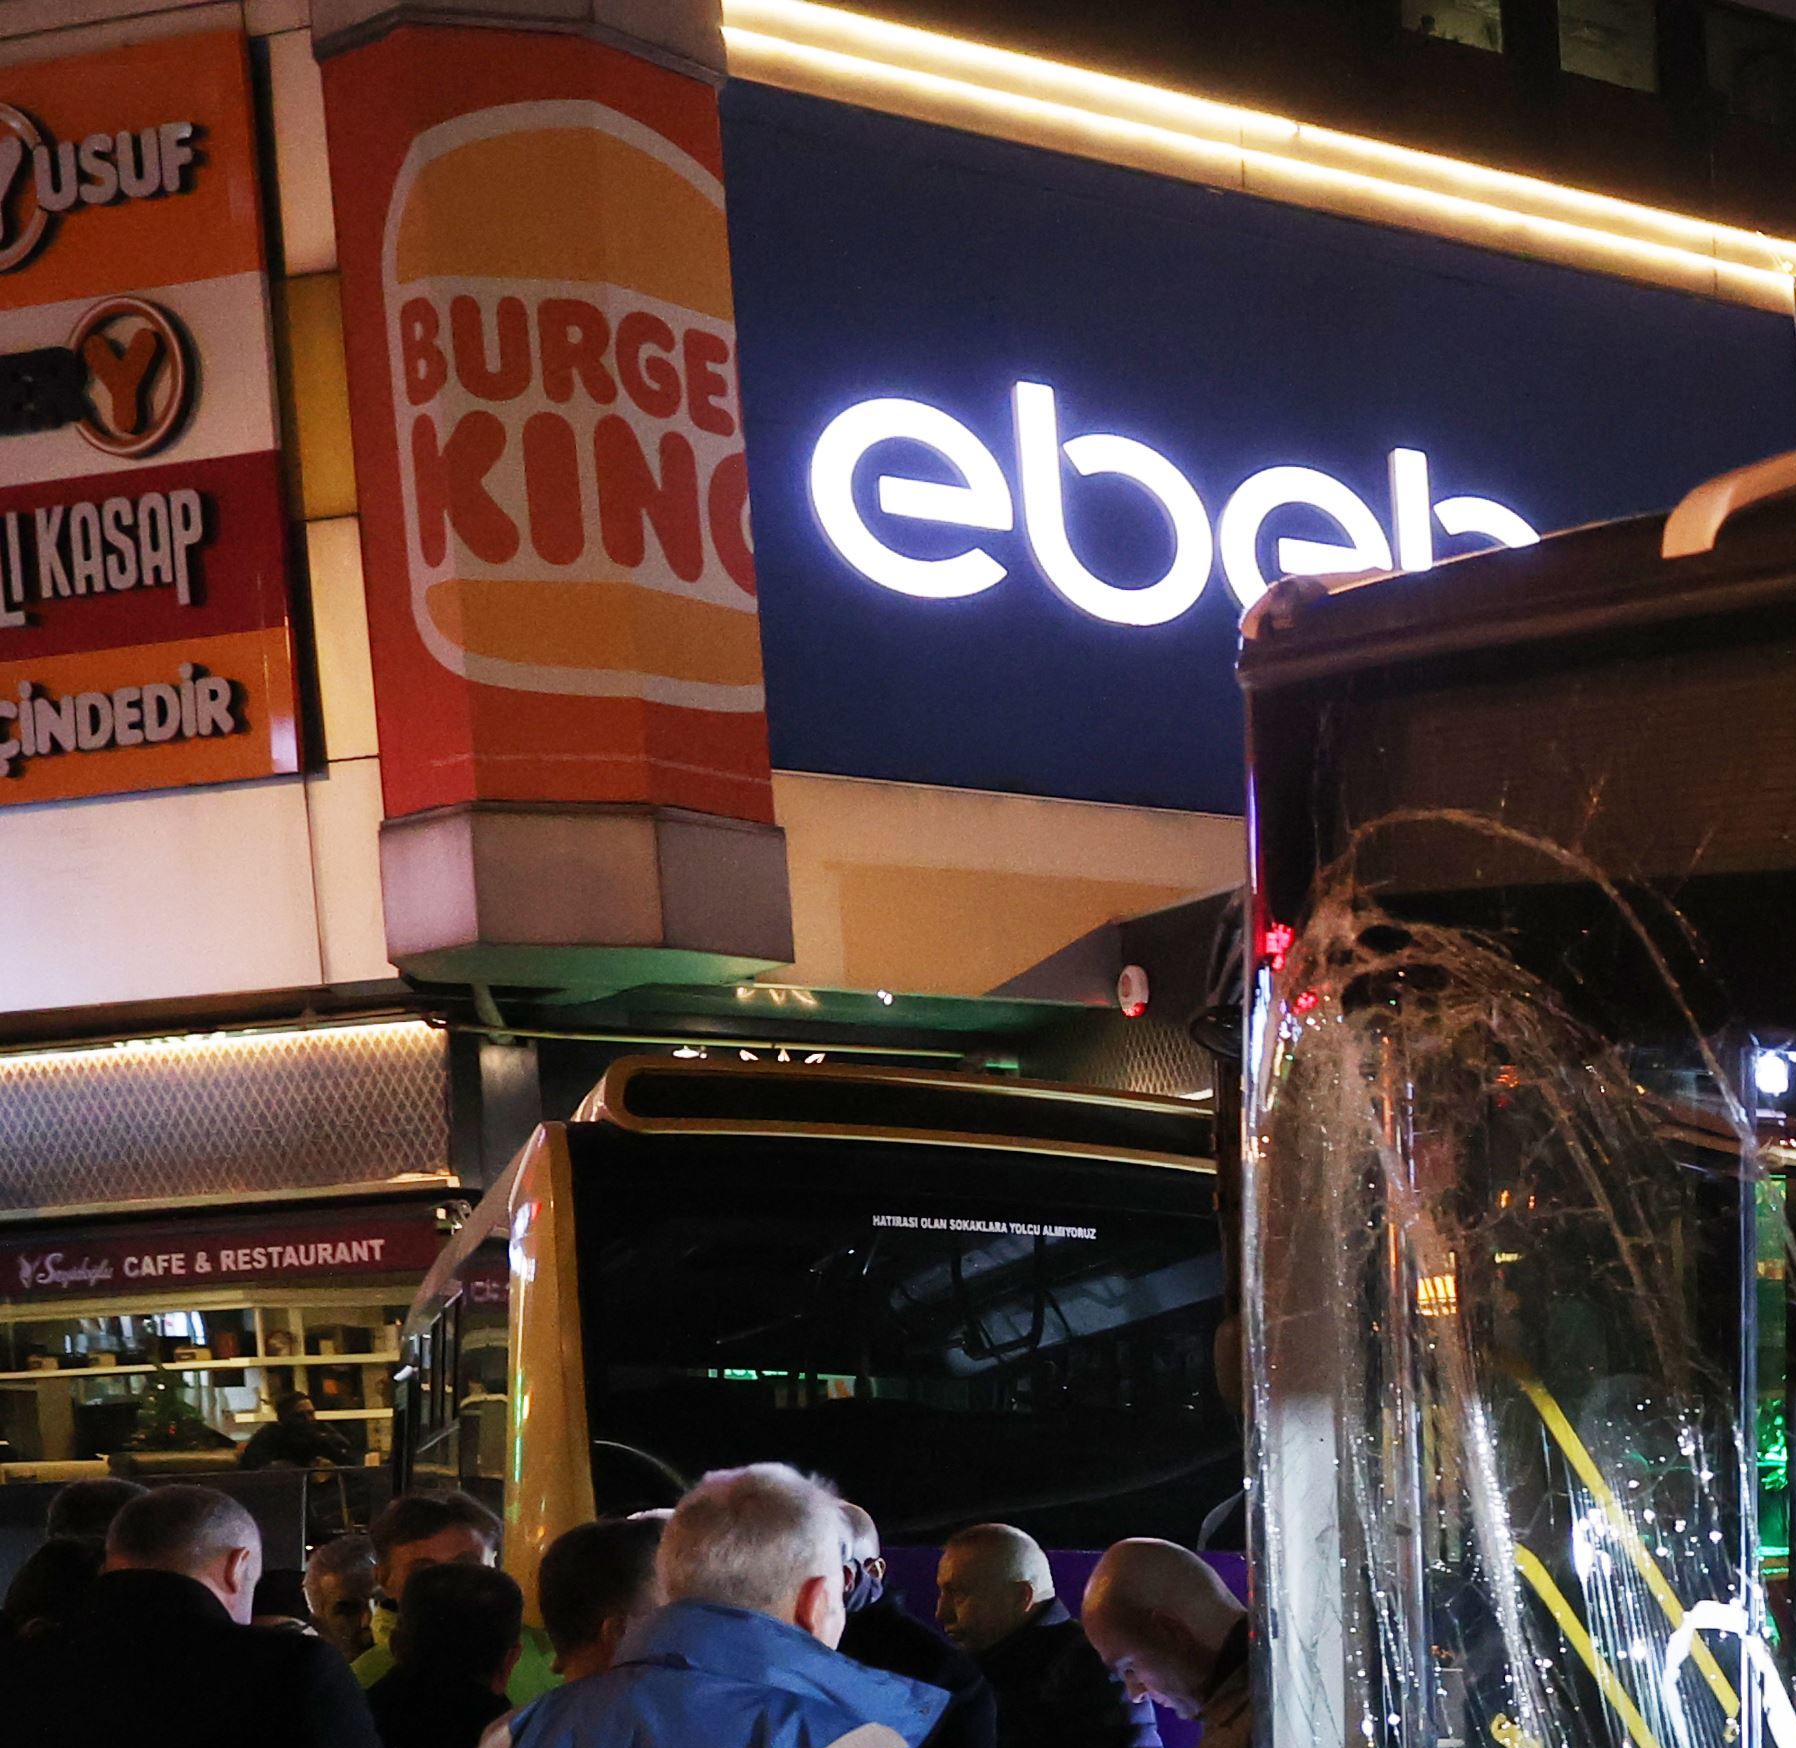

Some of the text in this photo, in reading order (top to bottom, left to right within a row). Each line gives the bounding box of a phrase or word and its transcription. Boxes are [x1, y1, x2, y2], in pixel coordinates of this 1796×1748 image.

[400, 294, 742, 437] BURGE
[35, 488, 203, 606] KASAP
[124, 1253, 186, 1278] CAFE
[195, 1251, 212, 1273] &
[220, 1238, 385, 1272] RESTAURANT
[920, 1217, 948, 1230] OLAN
[1009, 1222, 1041, 1236] YOLCU
